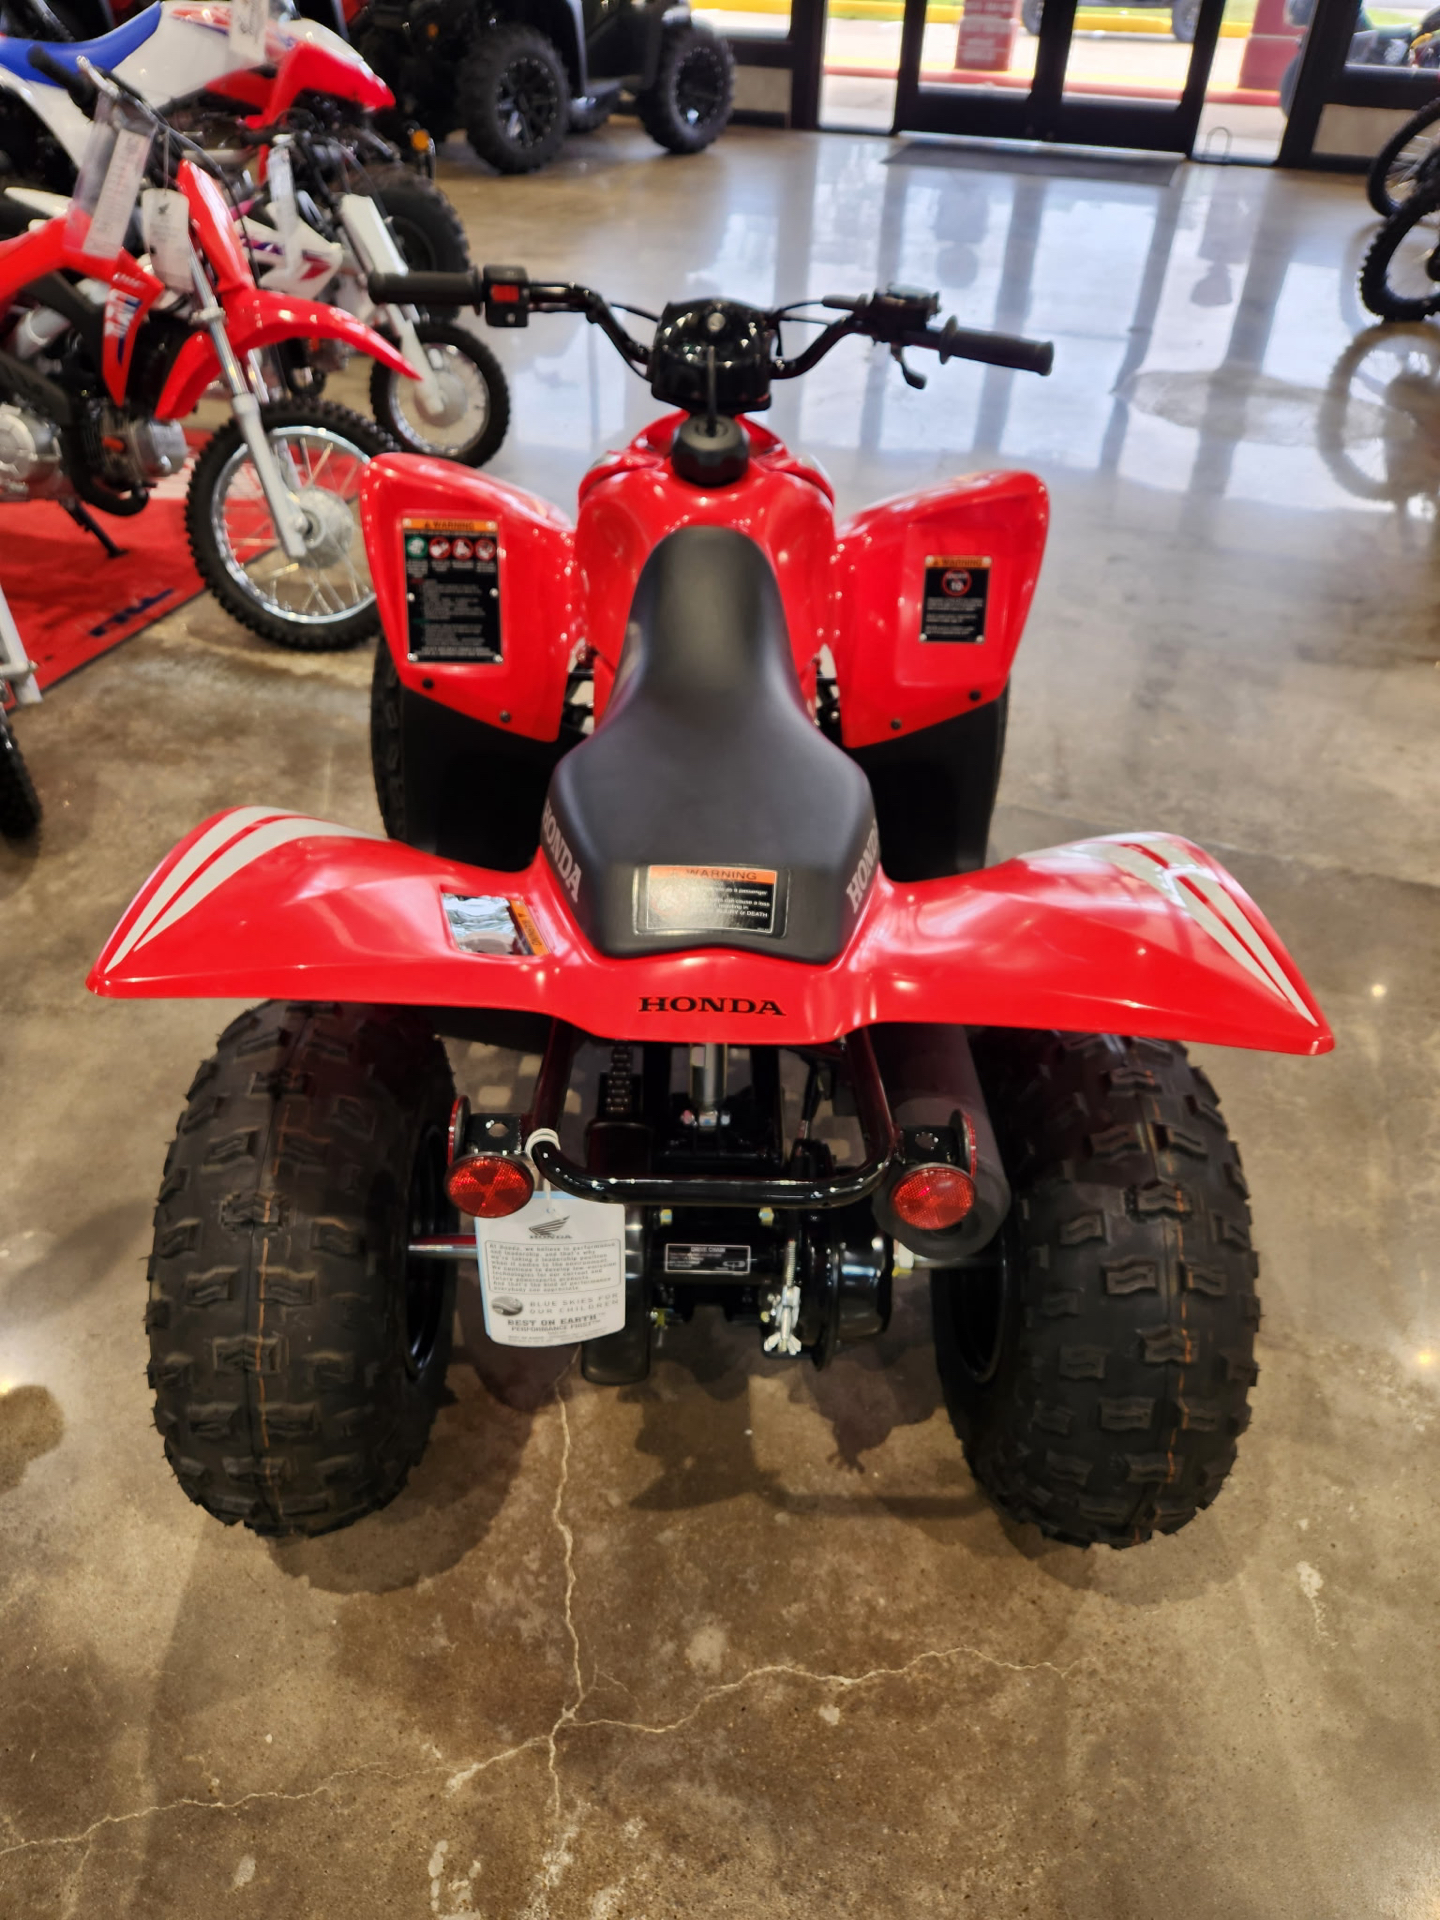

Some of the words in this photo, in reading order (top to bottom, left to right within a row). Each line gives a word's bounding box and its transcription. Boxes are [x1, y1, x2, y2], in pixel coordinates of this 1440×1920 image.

[542, 797, 582, 903] HONDA
[686, 869, 757, 881] WARNING
[746, 910, 768, 918] DEATH
[638, 996, 787, 1017] HONDA
[562, 1297, 594, 1306] SKIES
[598, 1293, 619, 1301] FOR
[559, 1300, 620, 1313] CHILDREN
[511, 1323, 568, 1332] PERFORMANCE
